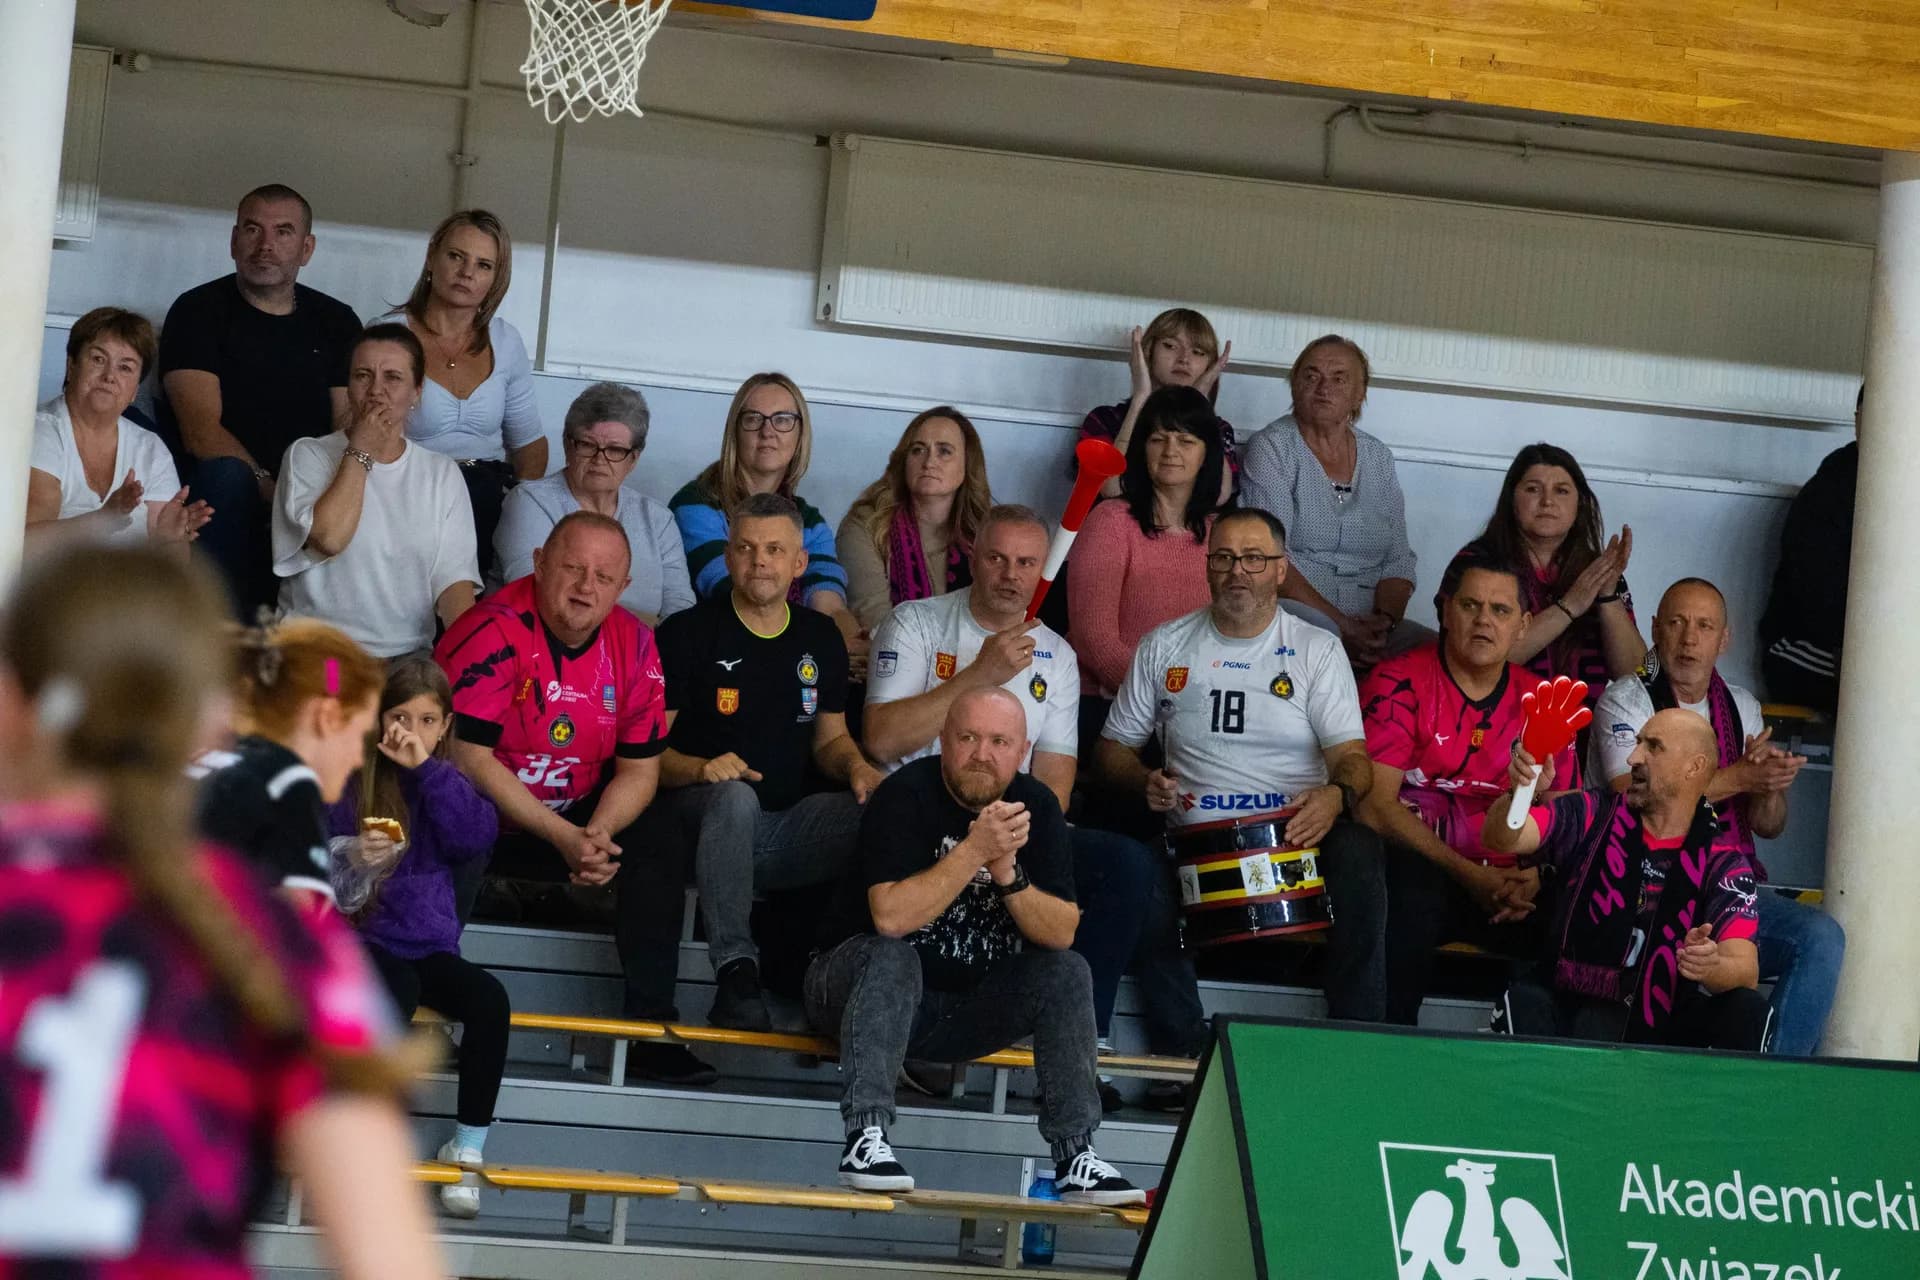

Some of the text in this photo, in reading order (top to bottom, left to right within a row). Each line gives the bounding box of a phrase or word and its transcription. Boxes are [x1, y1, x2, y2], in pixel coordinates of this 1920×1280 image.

[1032, 651, 1053, 659] ma
[936, 663, 952, 677] CK
[1222, 660, 1252, 670] PGNiG
[1167, 677, 1183, 690] CK
[719, 698, 736, 713] CK
[1209, 689, 1246, 734] 18
[517, 753, 581, 787] 32
[1200, 793, 1287, 810] SUZUK
[0, 958, 148, 1256] 1
[1619, 1162, 1920, 1231] Akademicki
